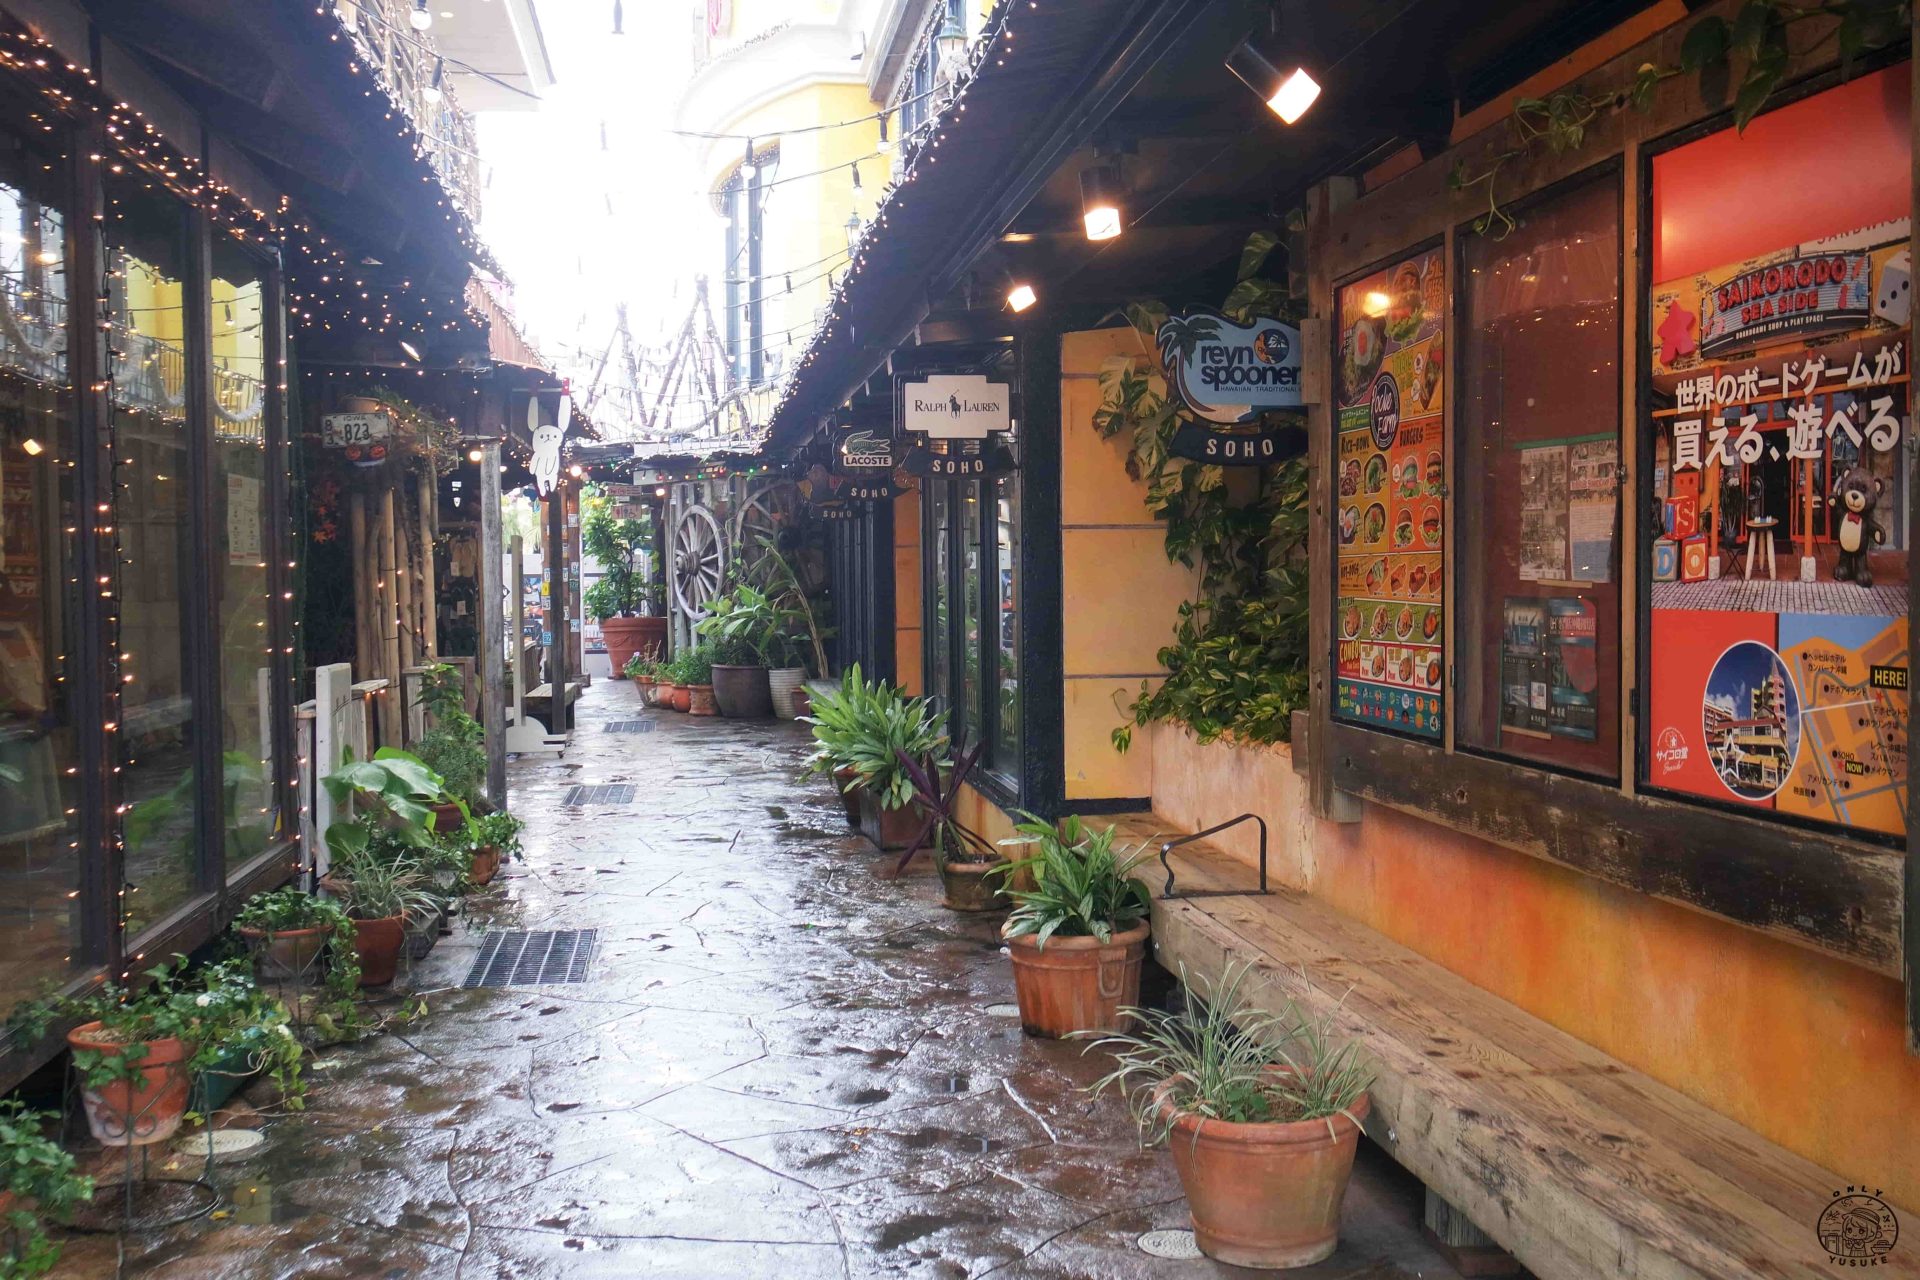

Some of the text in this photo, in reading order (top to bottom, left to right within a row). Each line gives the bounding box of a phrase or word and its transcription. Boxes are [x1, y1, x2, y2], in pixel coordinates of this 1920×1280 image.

[1718, 256, 1847, 312] SAIKORODO
[1741, 288, 1819, 324] SEA SIDE
[1805, 314, 1824, 324] SPACE
[1201, 346, 1254, 367] reyn
[1201, 366, 1301, 391] spooner
[1675, 342, 1903, 414] 世界のボードゲームが
[914, 400, 1000, 412] RALPH LAUREN
[344, 423, 370, 441] 823
[1672, 395, 1900, 472] 買える、遊べる
[1206, 439, 1274, 457] SOHO
[845, 456, 889, 465] LACOSTE
[932, 459, 984, 474] SOHO
[850, 487, 888, 498] SOHO
[823, 510, 852, 518] SOHO
[1657, 546, 1673, 576] D
[1874, 669, 1906, 687] HERE!
[1846, 762, 1863, 773] NOW
